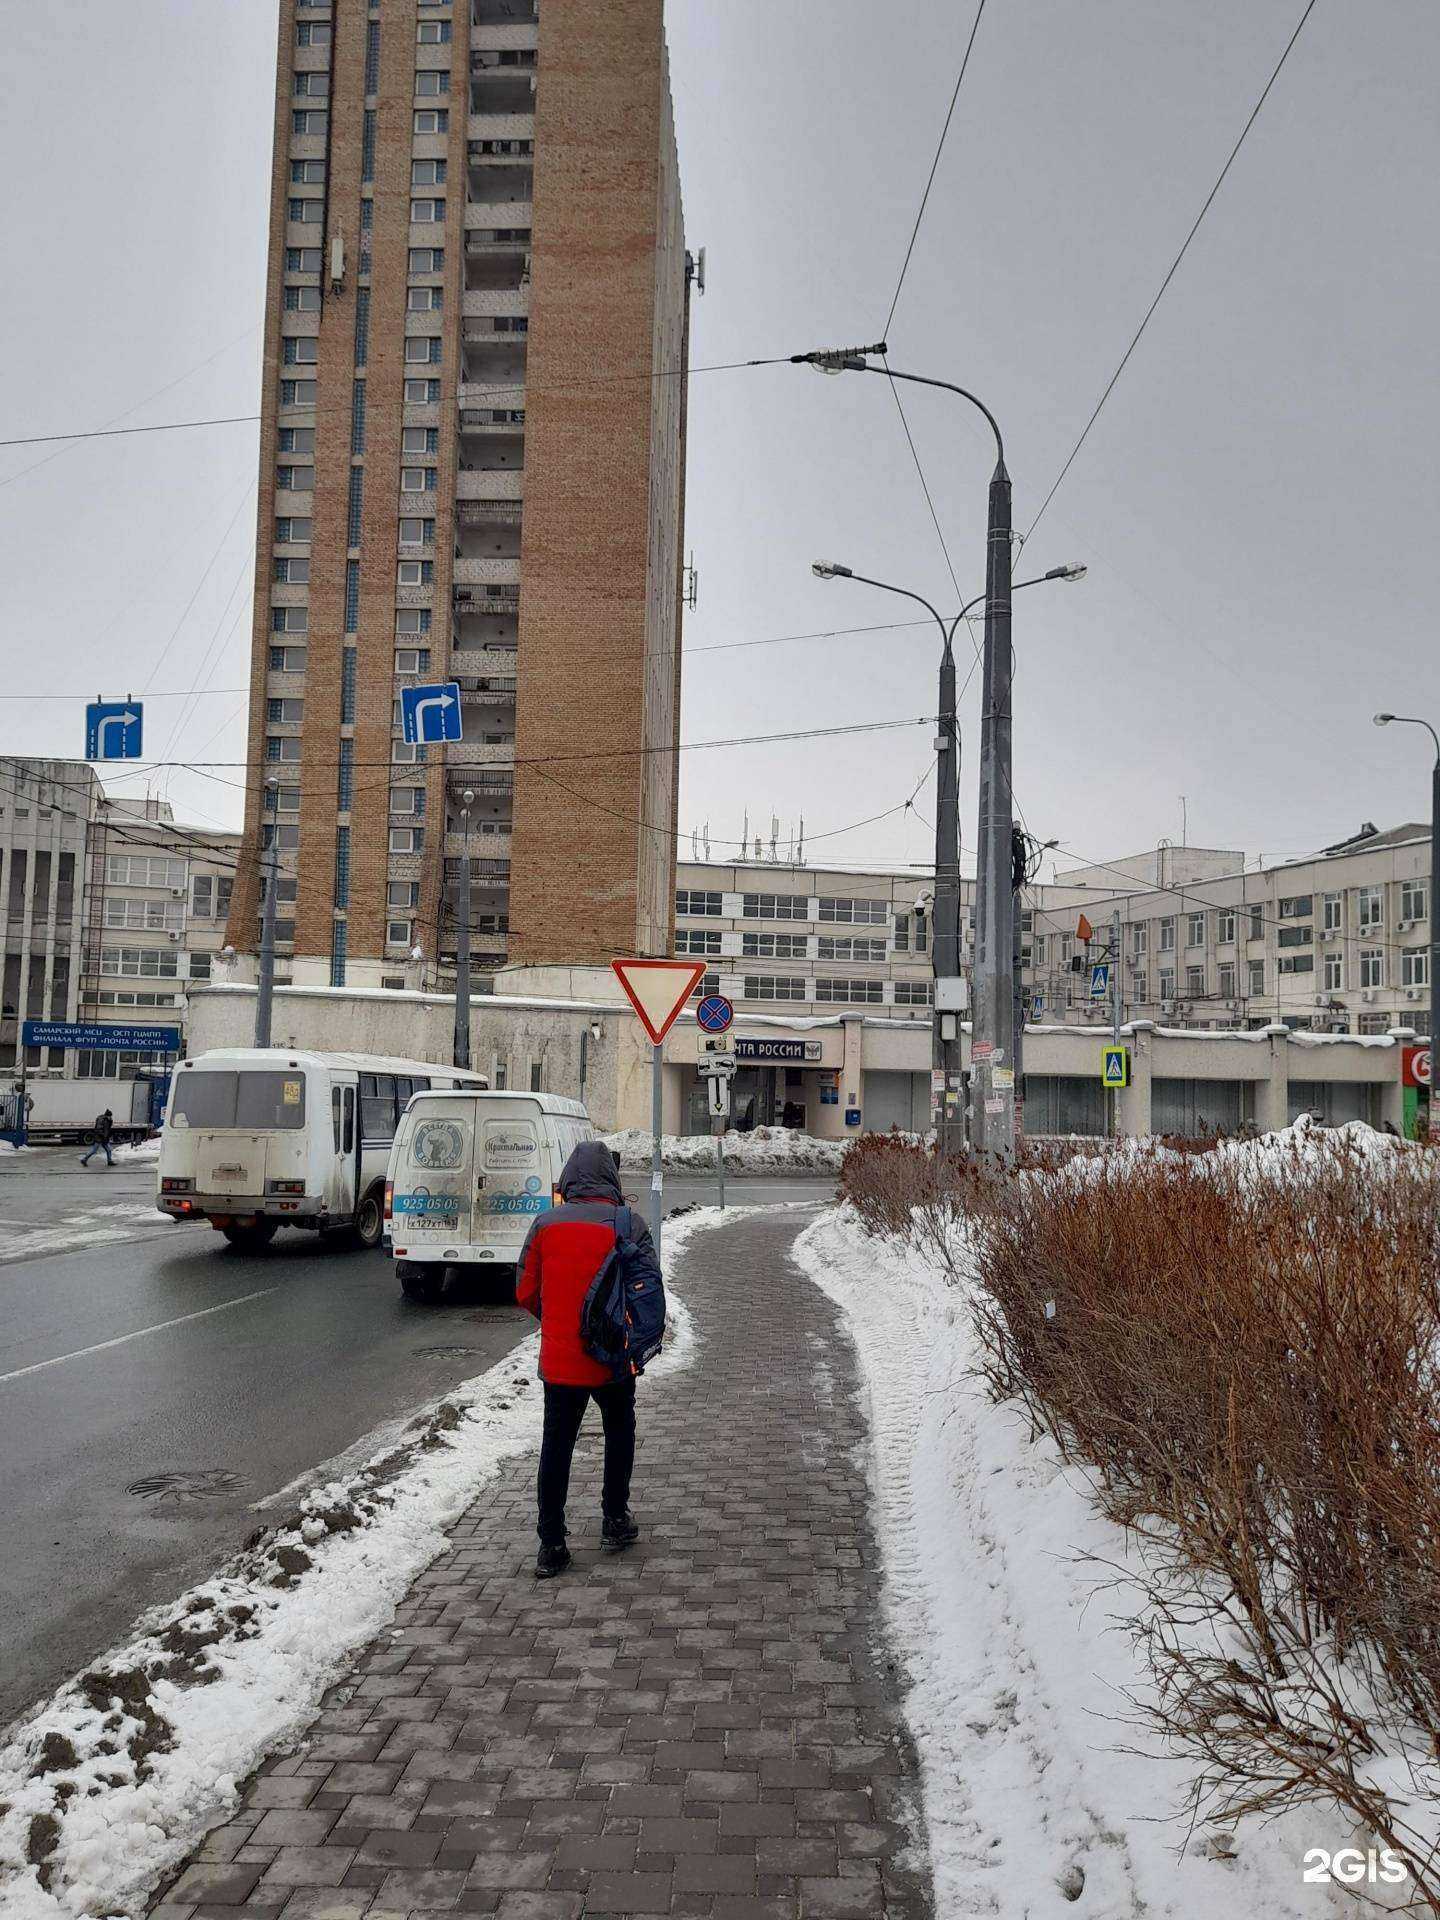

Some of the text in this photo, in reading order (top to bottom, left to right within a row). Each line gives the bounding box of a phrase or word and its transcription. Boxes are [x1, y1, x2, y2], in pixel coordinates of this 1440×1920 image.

[33, 1027, 81, 1035] САМАРСКИЙ
[112, 1029, 131, 1037] ОСП
[758, 1043, 802, 1056] РОССИИ
[403, 1198, 459, 1210] 925 05 05
[508, 1199, 523, 1211] 05
[526, 1199, 542, 1211] 05
